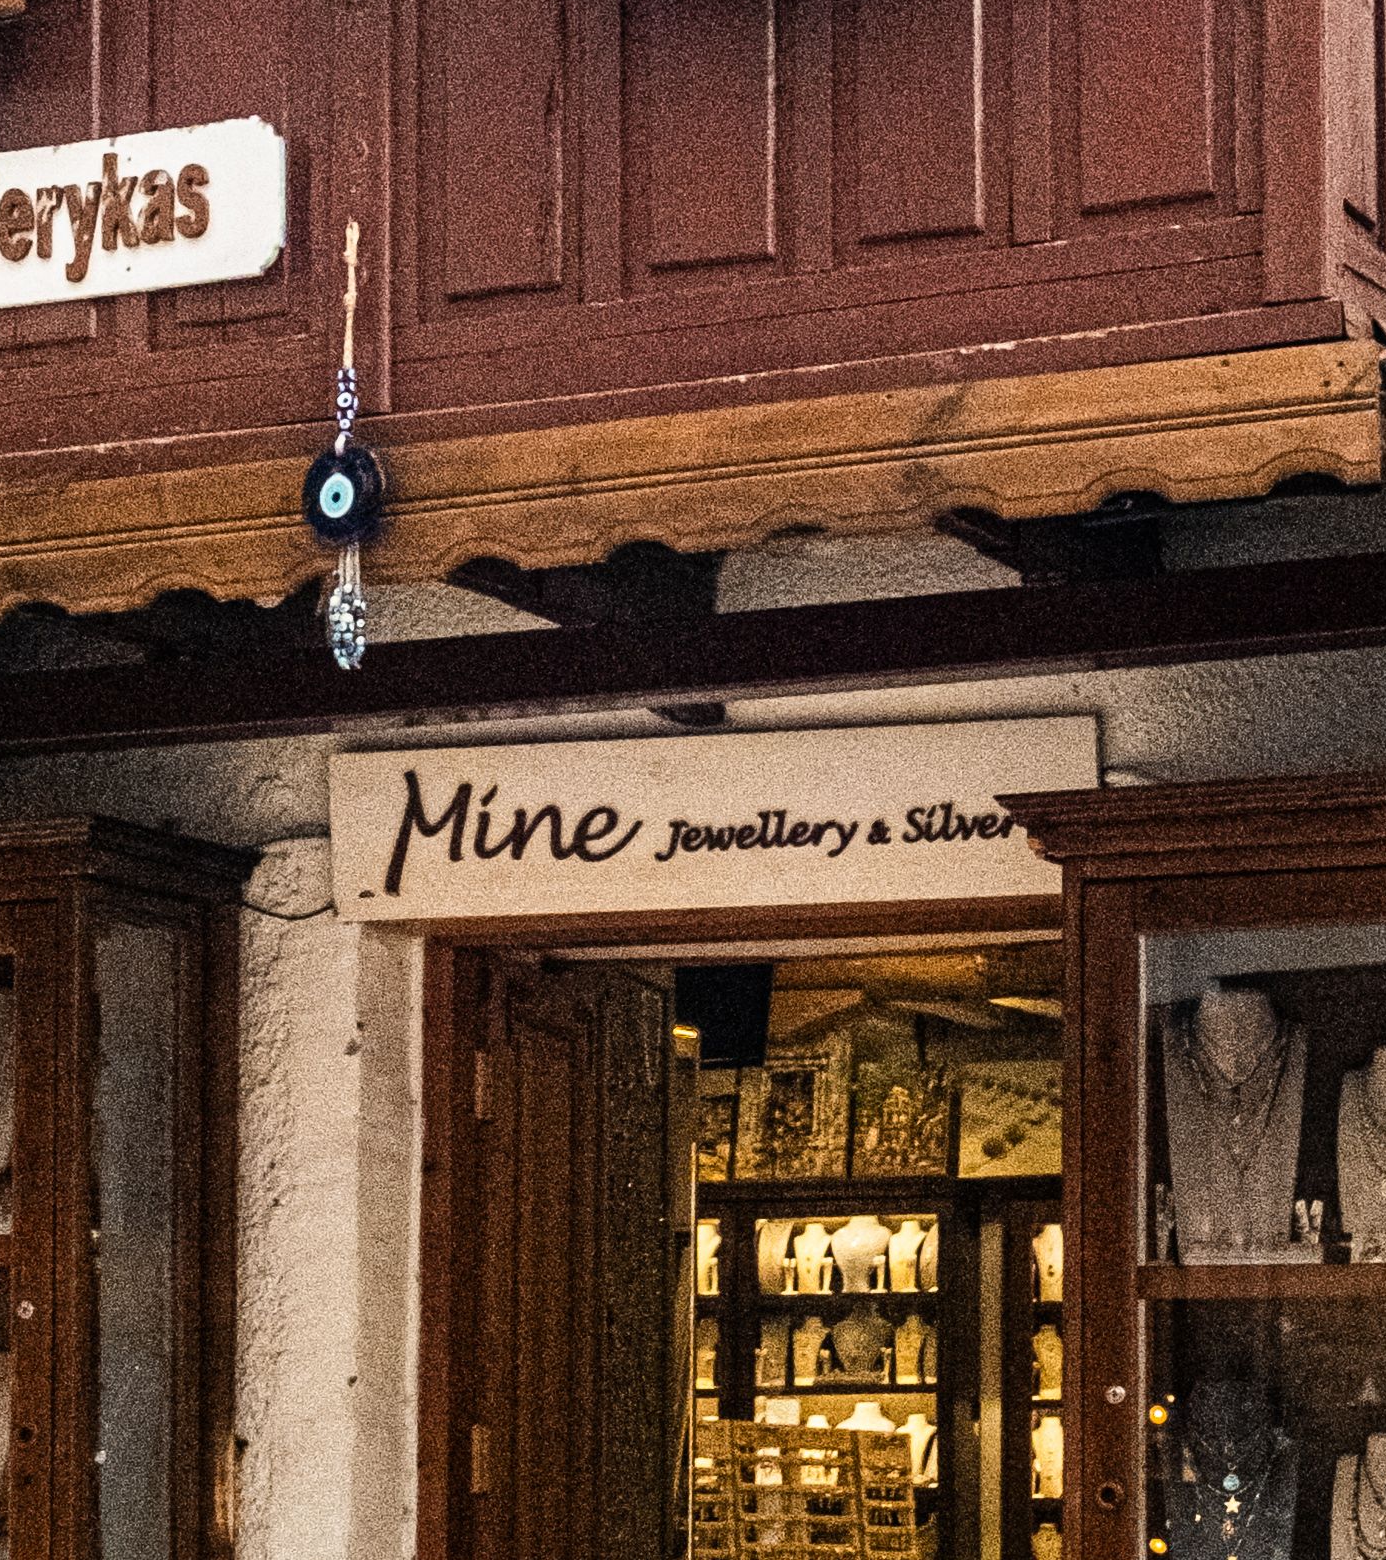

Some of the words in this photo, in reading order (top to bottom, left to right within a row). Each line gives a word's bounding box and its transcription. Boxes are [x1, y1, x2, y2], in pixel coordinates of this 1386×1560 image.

[383, 769, 643, 896] Mine
[655, 810, 858, 862] Jewellery
[866, 816, 891, 846] &
[903, 801, 1014, 842] Silver
